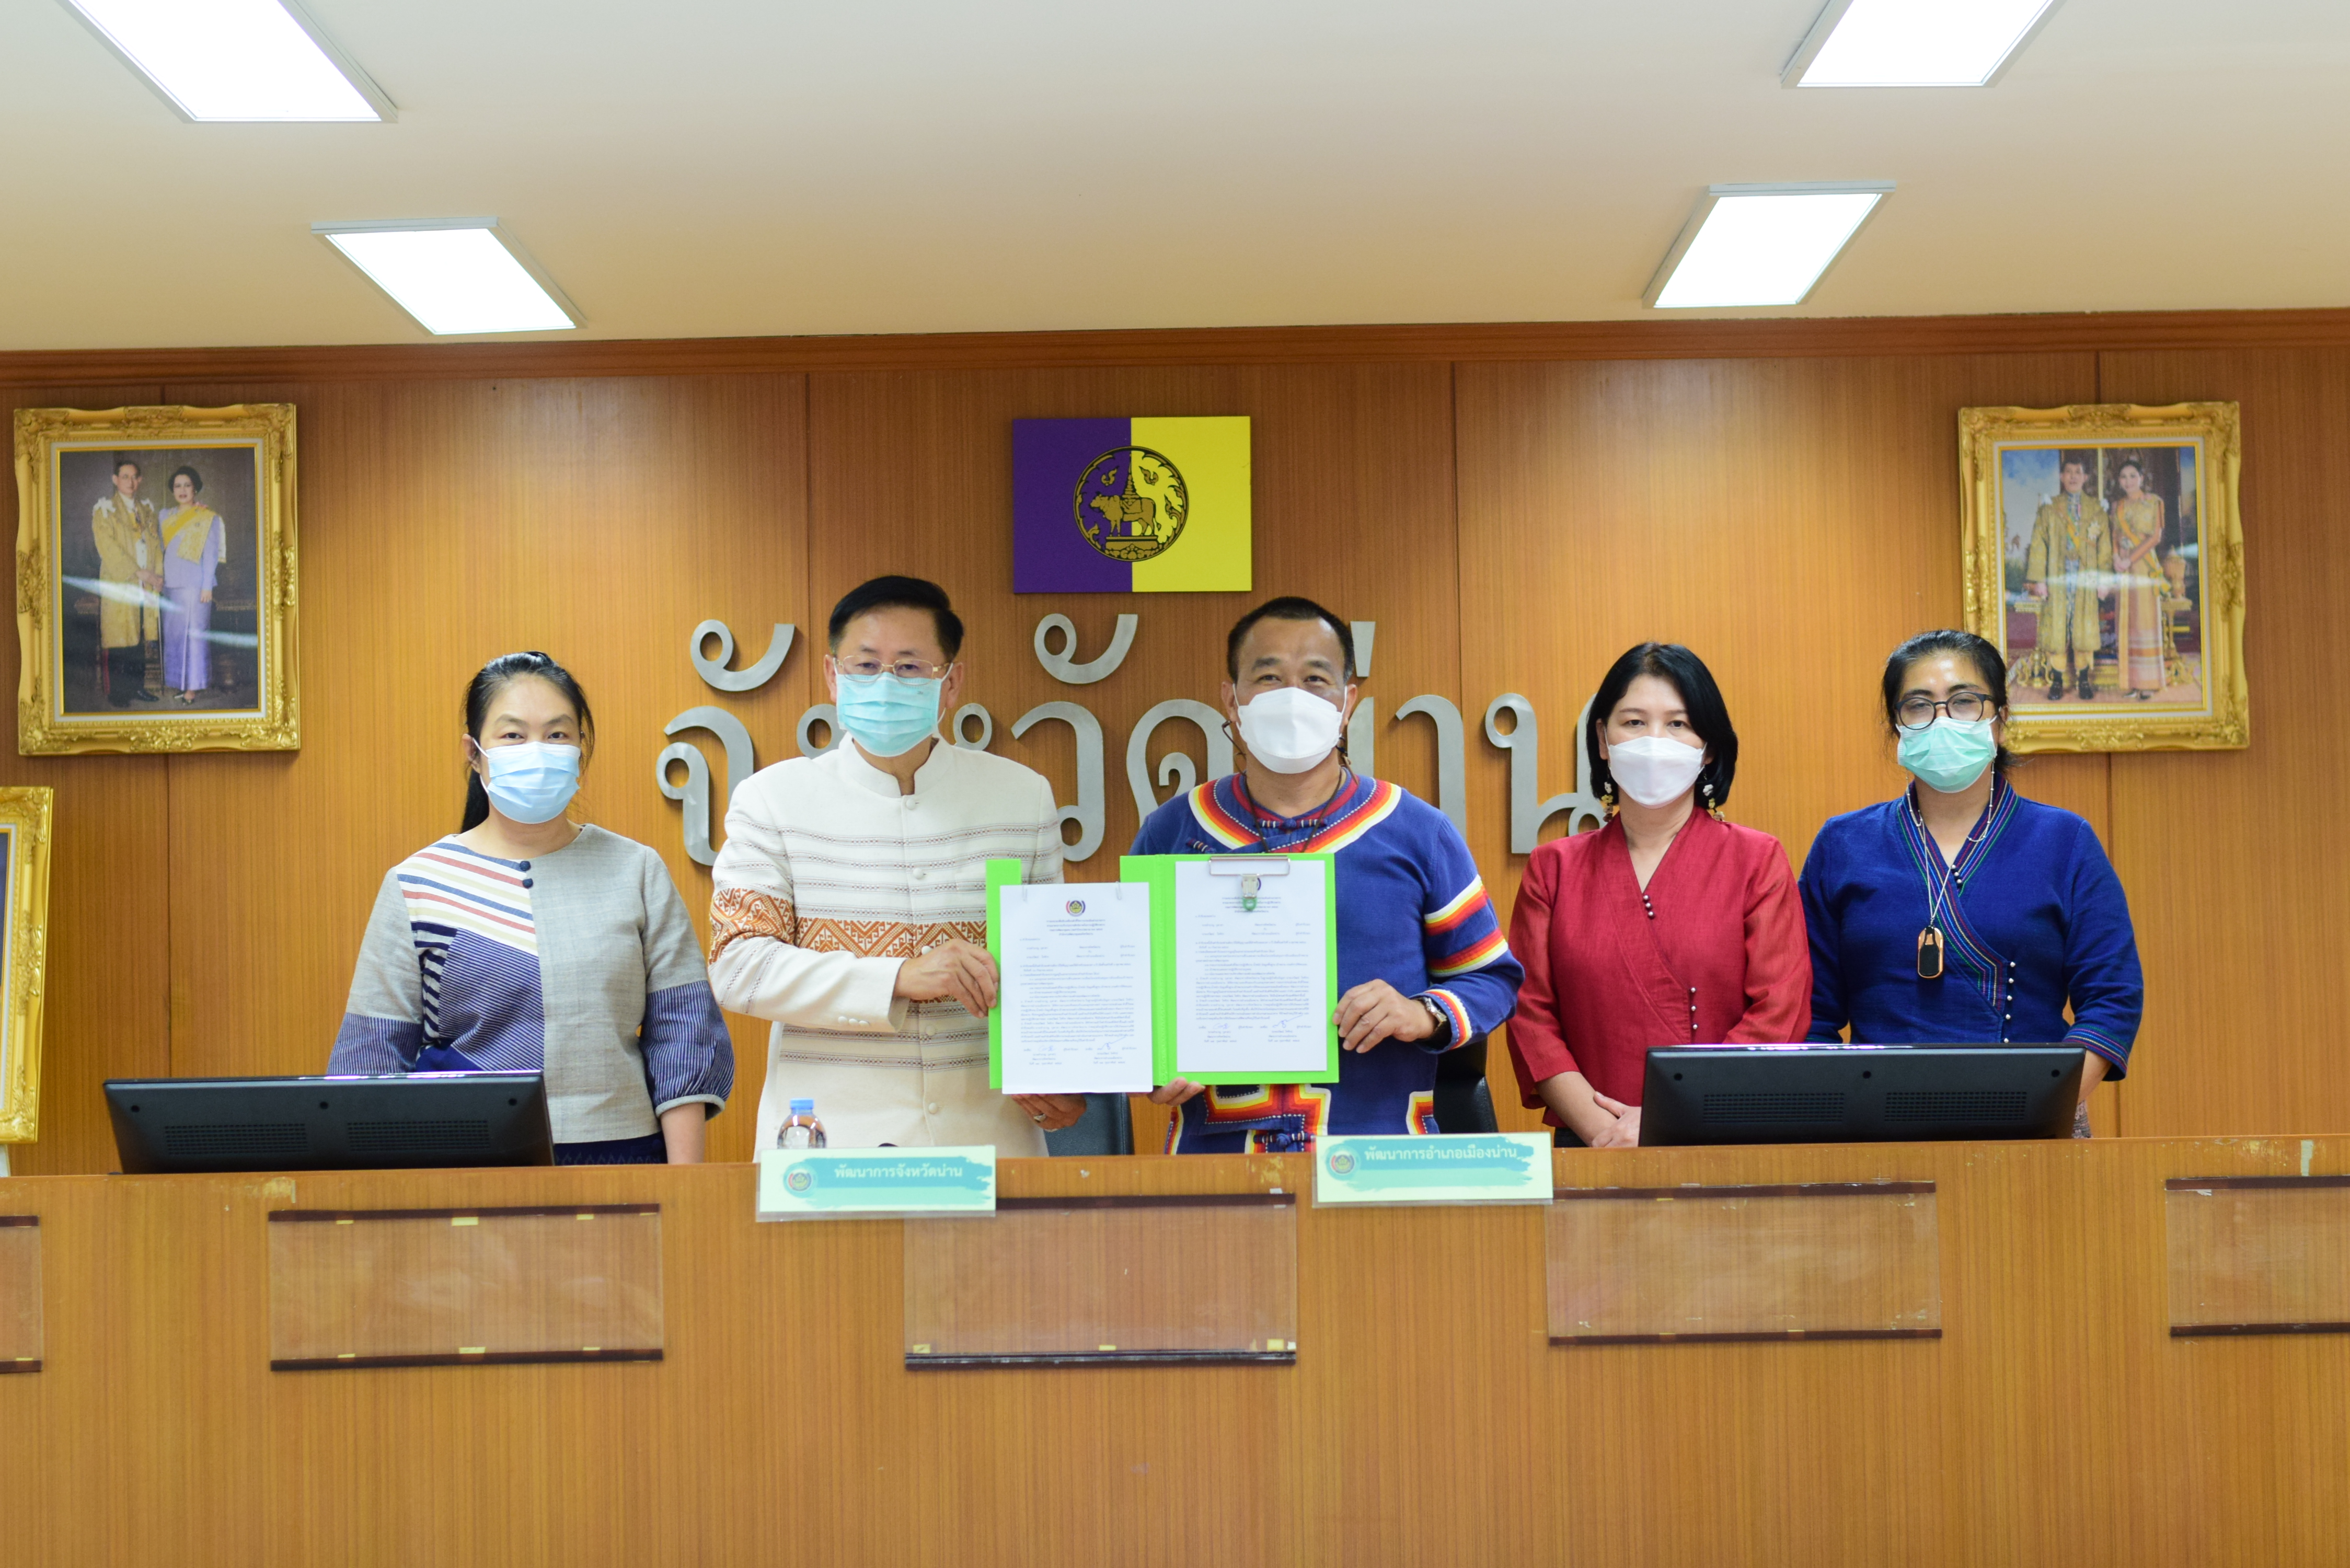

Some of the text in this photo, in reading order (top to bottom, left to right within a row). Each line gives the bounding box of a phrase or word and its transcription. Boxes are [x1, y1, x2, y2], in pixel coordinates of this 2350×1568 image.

[1364, 1144, 1517, 1160] พัฒนาการอำเภอเมืองน่าน
[834, 1163, 963, 1178] พัฒนาการจังหวัดน่าน
